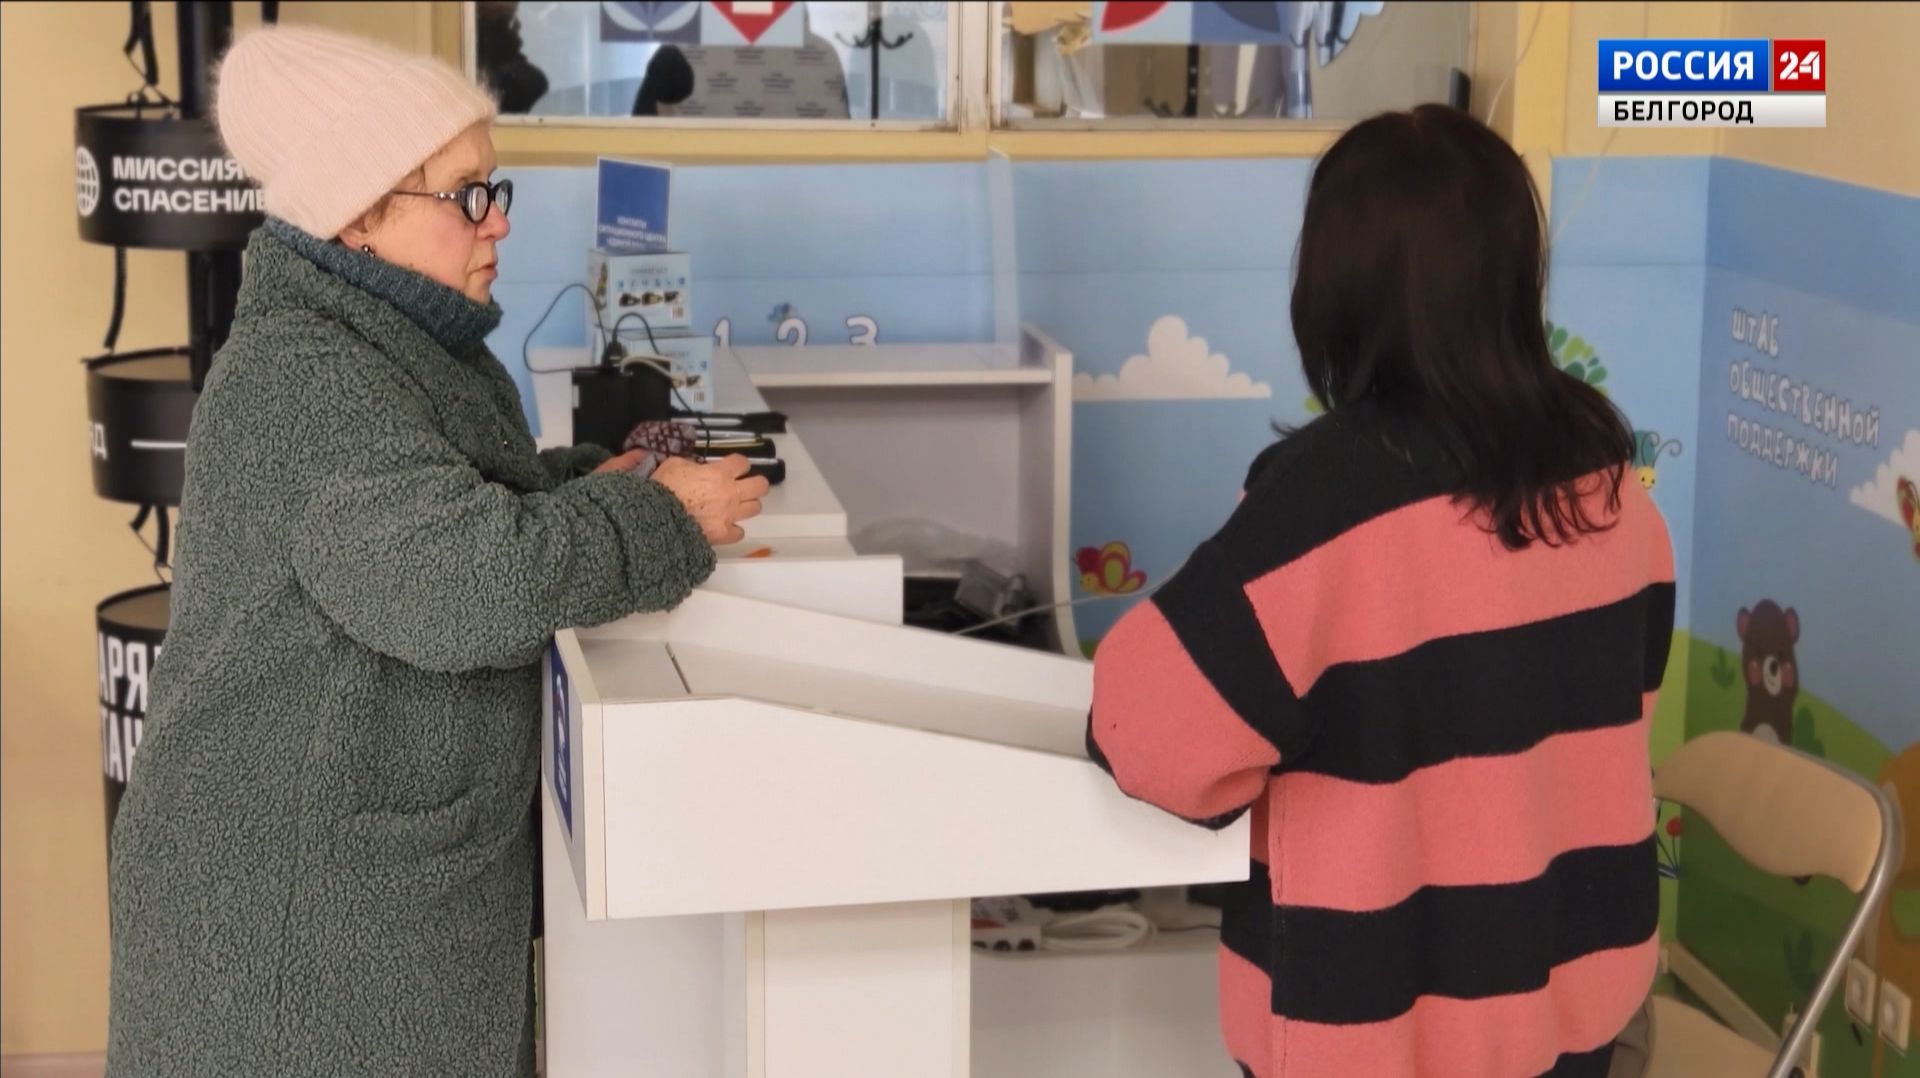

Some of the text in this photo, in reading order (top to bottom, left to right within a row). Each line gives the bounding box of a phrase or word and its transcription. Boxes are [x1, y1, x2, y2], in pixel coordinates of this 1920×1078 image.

[1731, 309, 1779, 357] ШТАБ
[1729, 360, 1880, 447] ОБЩЕСТВЕННОЙ
[1727, 412, 1839, 488] ПОДДЕРЖКИ
